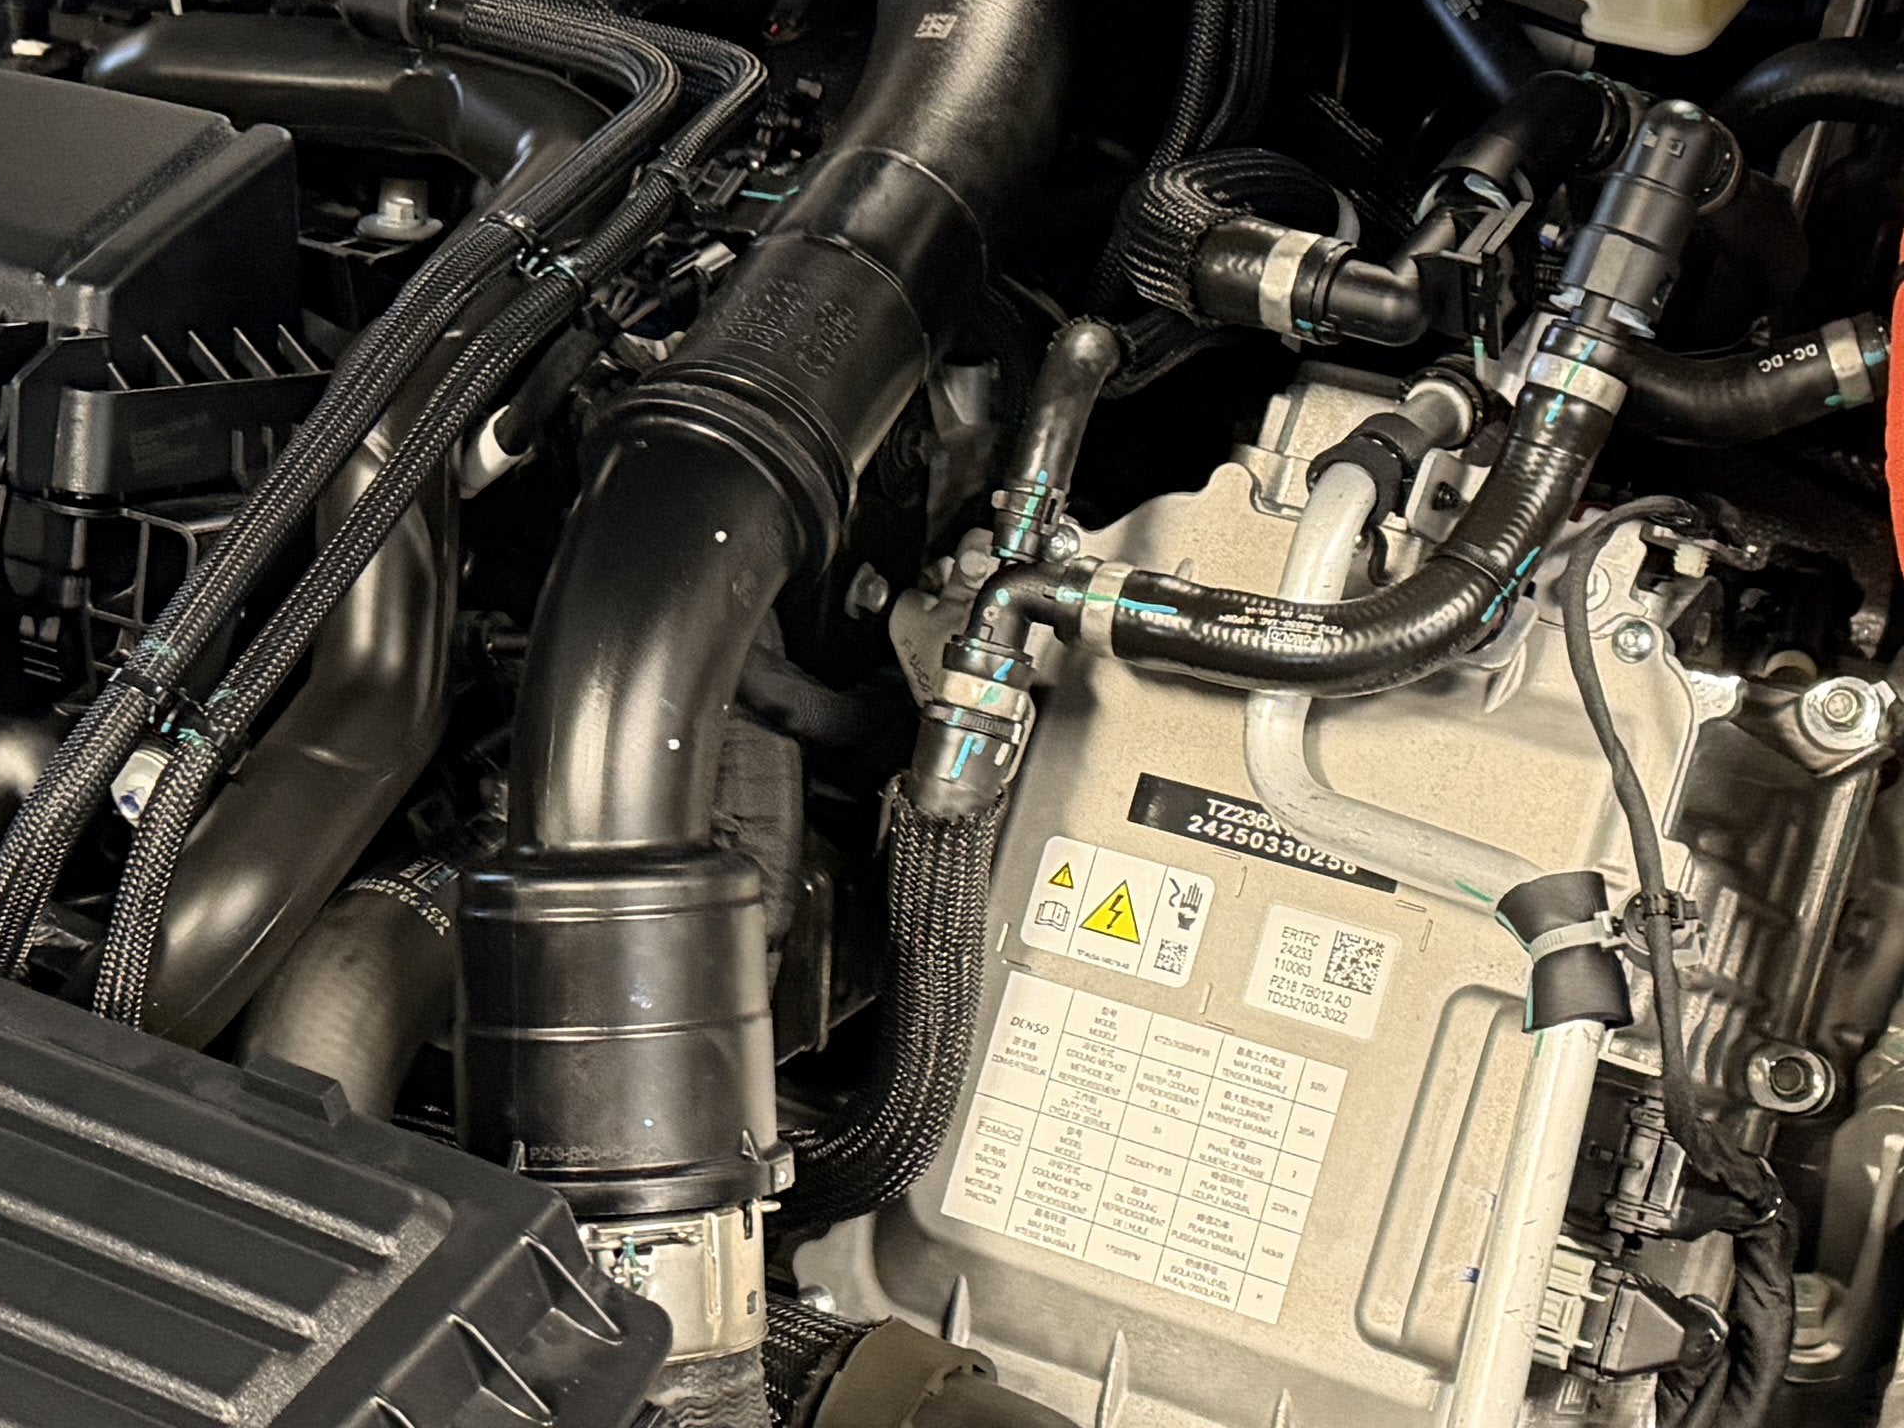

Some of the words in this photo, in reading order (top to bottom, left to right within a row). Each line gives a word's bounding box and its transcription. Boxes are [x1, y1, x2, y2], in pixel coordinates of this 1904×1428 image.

[1757, 341, 1821, 375] DC-DC
[1208, 799, 1294, 835] TZ236X
[1009, 1016, 1049, 1034] DENSO
[976, 1119, 1022, 1141] FoMoCo
